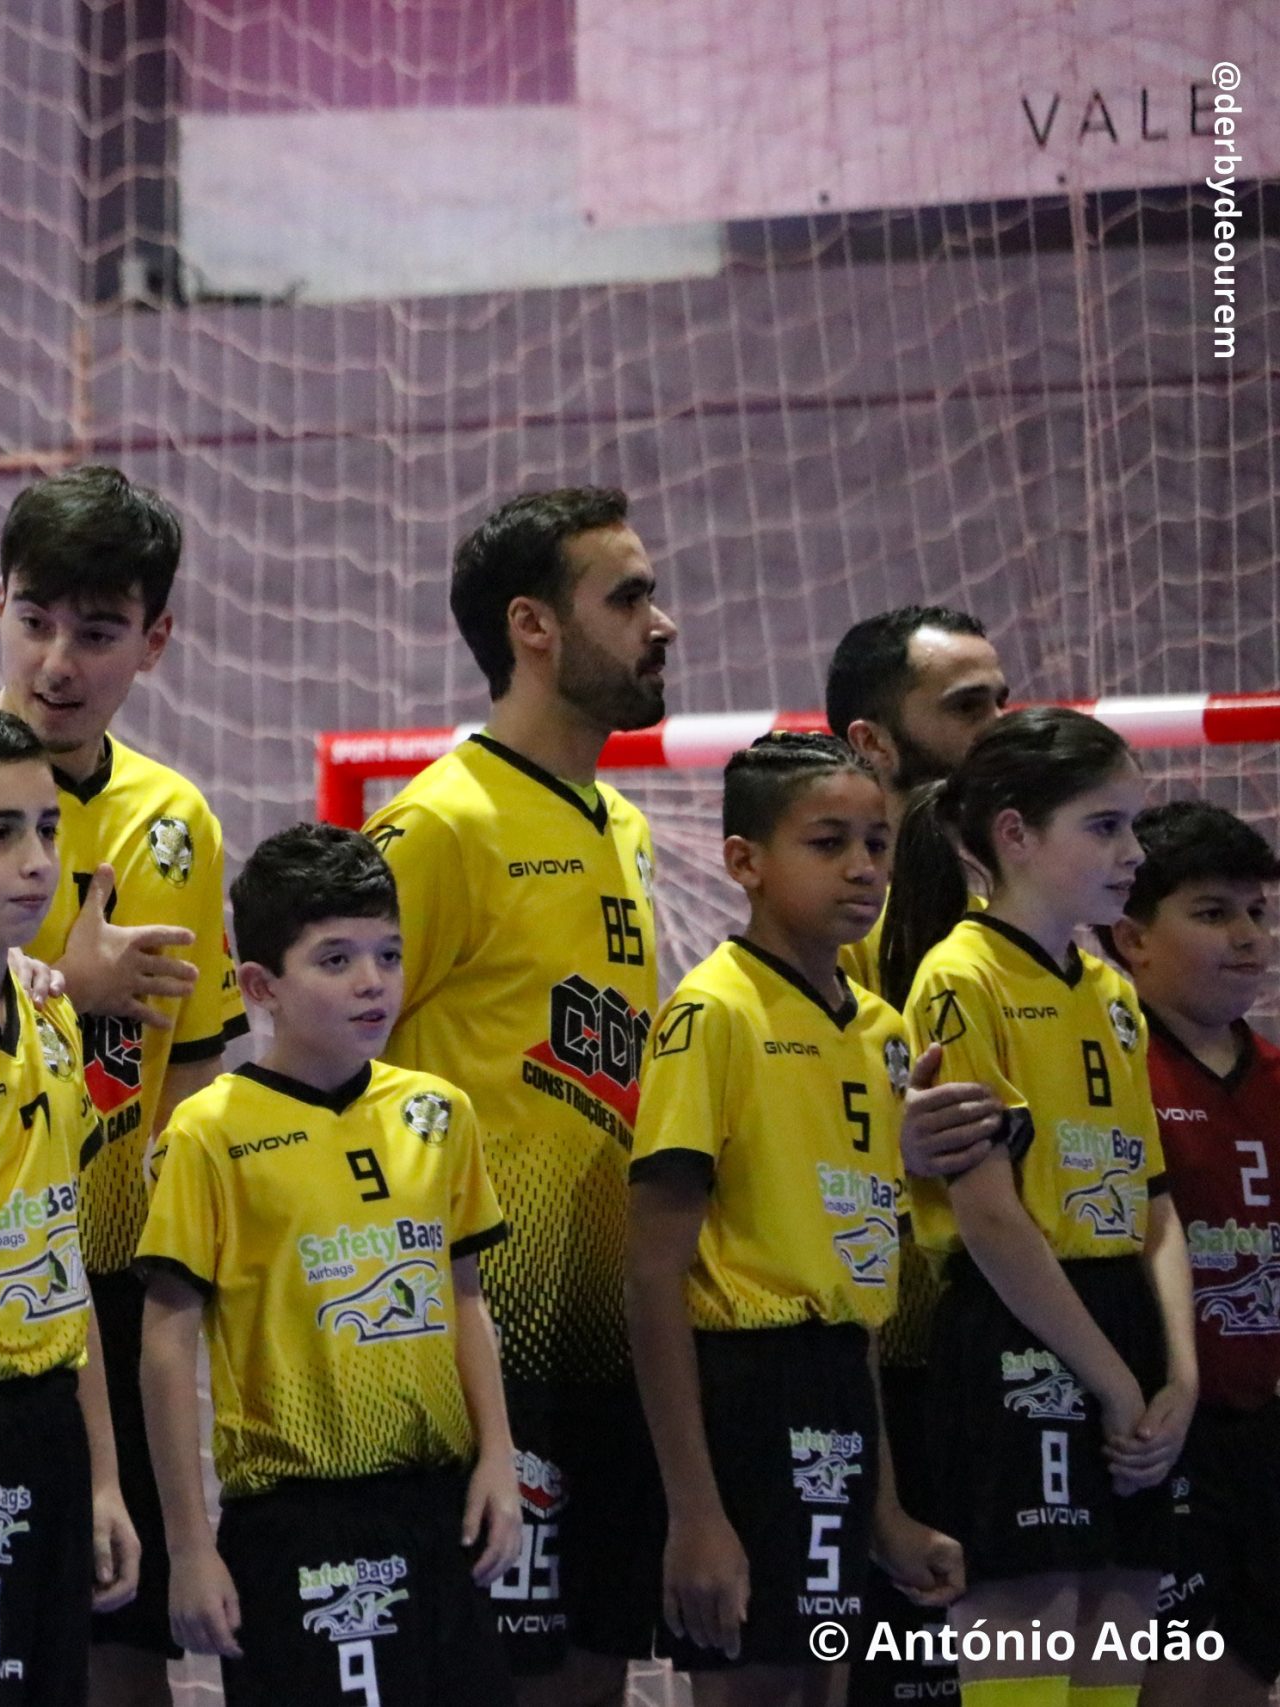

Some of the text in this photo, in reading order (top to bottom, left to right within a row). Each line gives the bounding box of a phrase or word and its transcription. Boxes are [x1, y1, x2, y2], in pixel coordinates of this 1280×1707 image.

[1022, 82, 1220, 150] VALE
[508, 859, 585, 878] GIVOVA
[600, 895, 645, 966] 85
[764, 1041, 820, 1057] GIVOVA
[1082, 1040, 1112, 1106] 8
[842, 1082, 870, 1153] 5
[1157, 1107, 1209, 1122] VOVA
[228, 1130, 308, 1160] GIVOVA
[346, 1148, 390, 1202] 9
[1234, 1140, 1270, 1206] 2
[299, 1219, 444, 1271] SafetyBags
[1188, 1218, 1280, 1264] SafetyB
[307, 1263, 356, 1283] Airbags
[1042, 1430, 1069, 1504] 8
[1016, 1507, 1091, 1527] GIVOVA
[806, 1515, 842, 1591] 5
[497, 1614, 567, 1634] IVOVA
[797, 1596, 861, 1616] IVOVA
[338, 1641, 382, 1707] 9
[894, 1679, 957, 1699] GIVO
